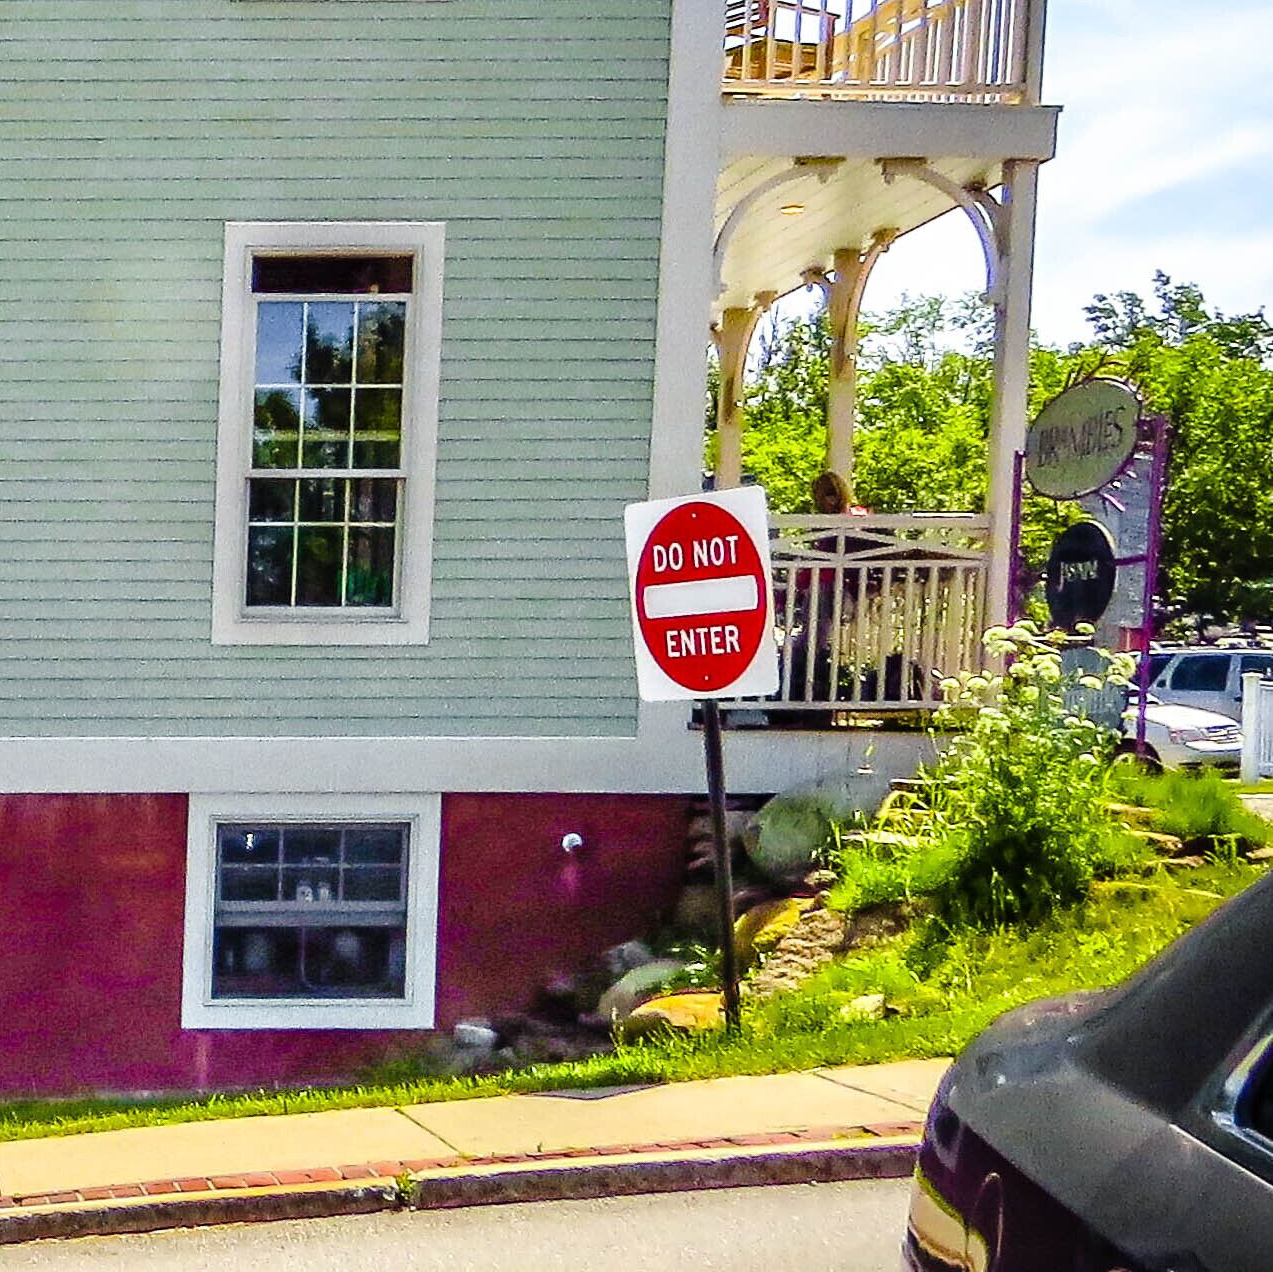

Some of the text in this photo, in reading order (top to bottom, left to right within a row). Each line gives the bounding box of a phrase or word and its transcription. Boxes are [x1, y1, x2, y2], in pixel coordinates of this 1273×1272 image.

[653, 536, 739, 572] DO NOT
[666, 625, 740, 658] ENTER
